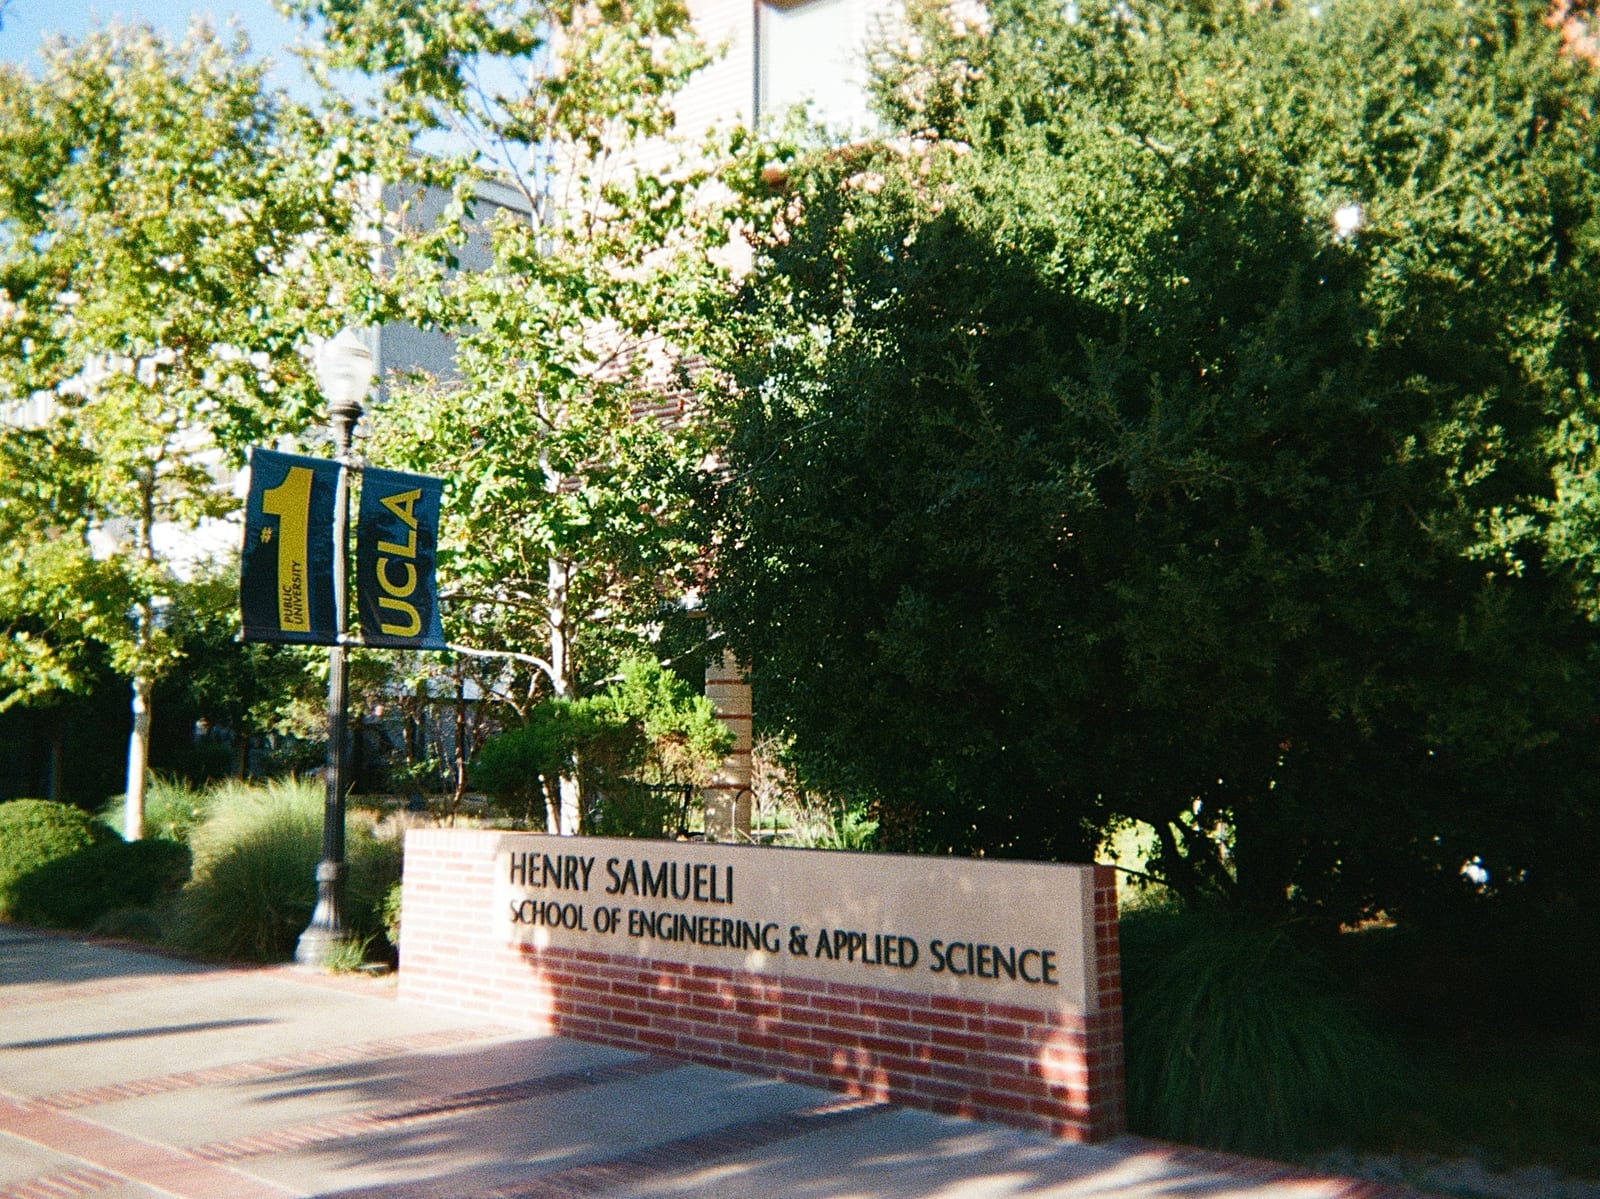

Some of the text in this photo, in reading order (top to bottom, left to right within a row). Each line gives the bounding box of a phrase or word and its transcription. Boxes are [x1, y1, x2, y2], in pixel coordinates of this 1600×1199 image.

[292, 560, 302, 625] UNIVERSITY
[376, 488, 422, 638] UCLA
[282, 585, 293, 624] PUBLIC
[510, 851, 733, 904] HENRY SAMUELI
[510, 899, 1059, 985] SCHOOL OF ENGINEERING & APPLIED SCIENCE
